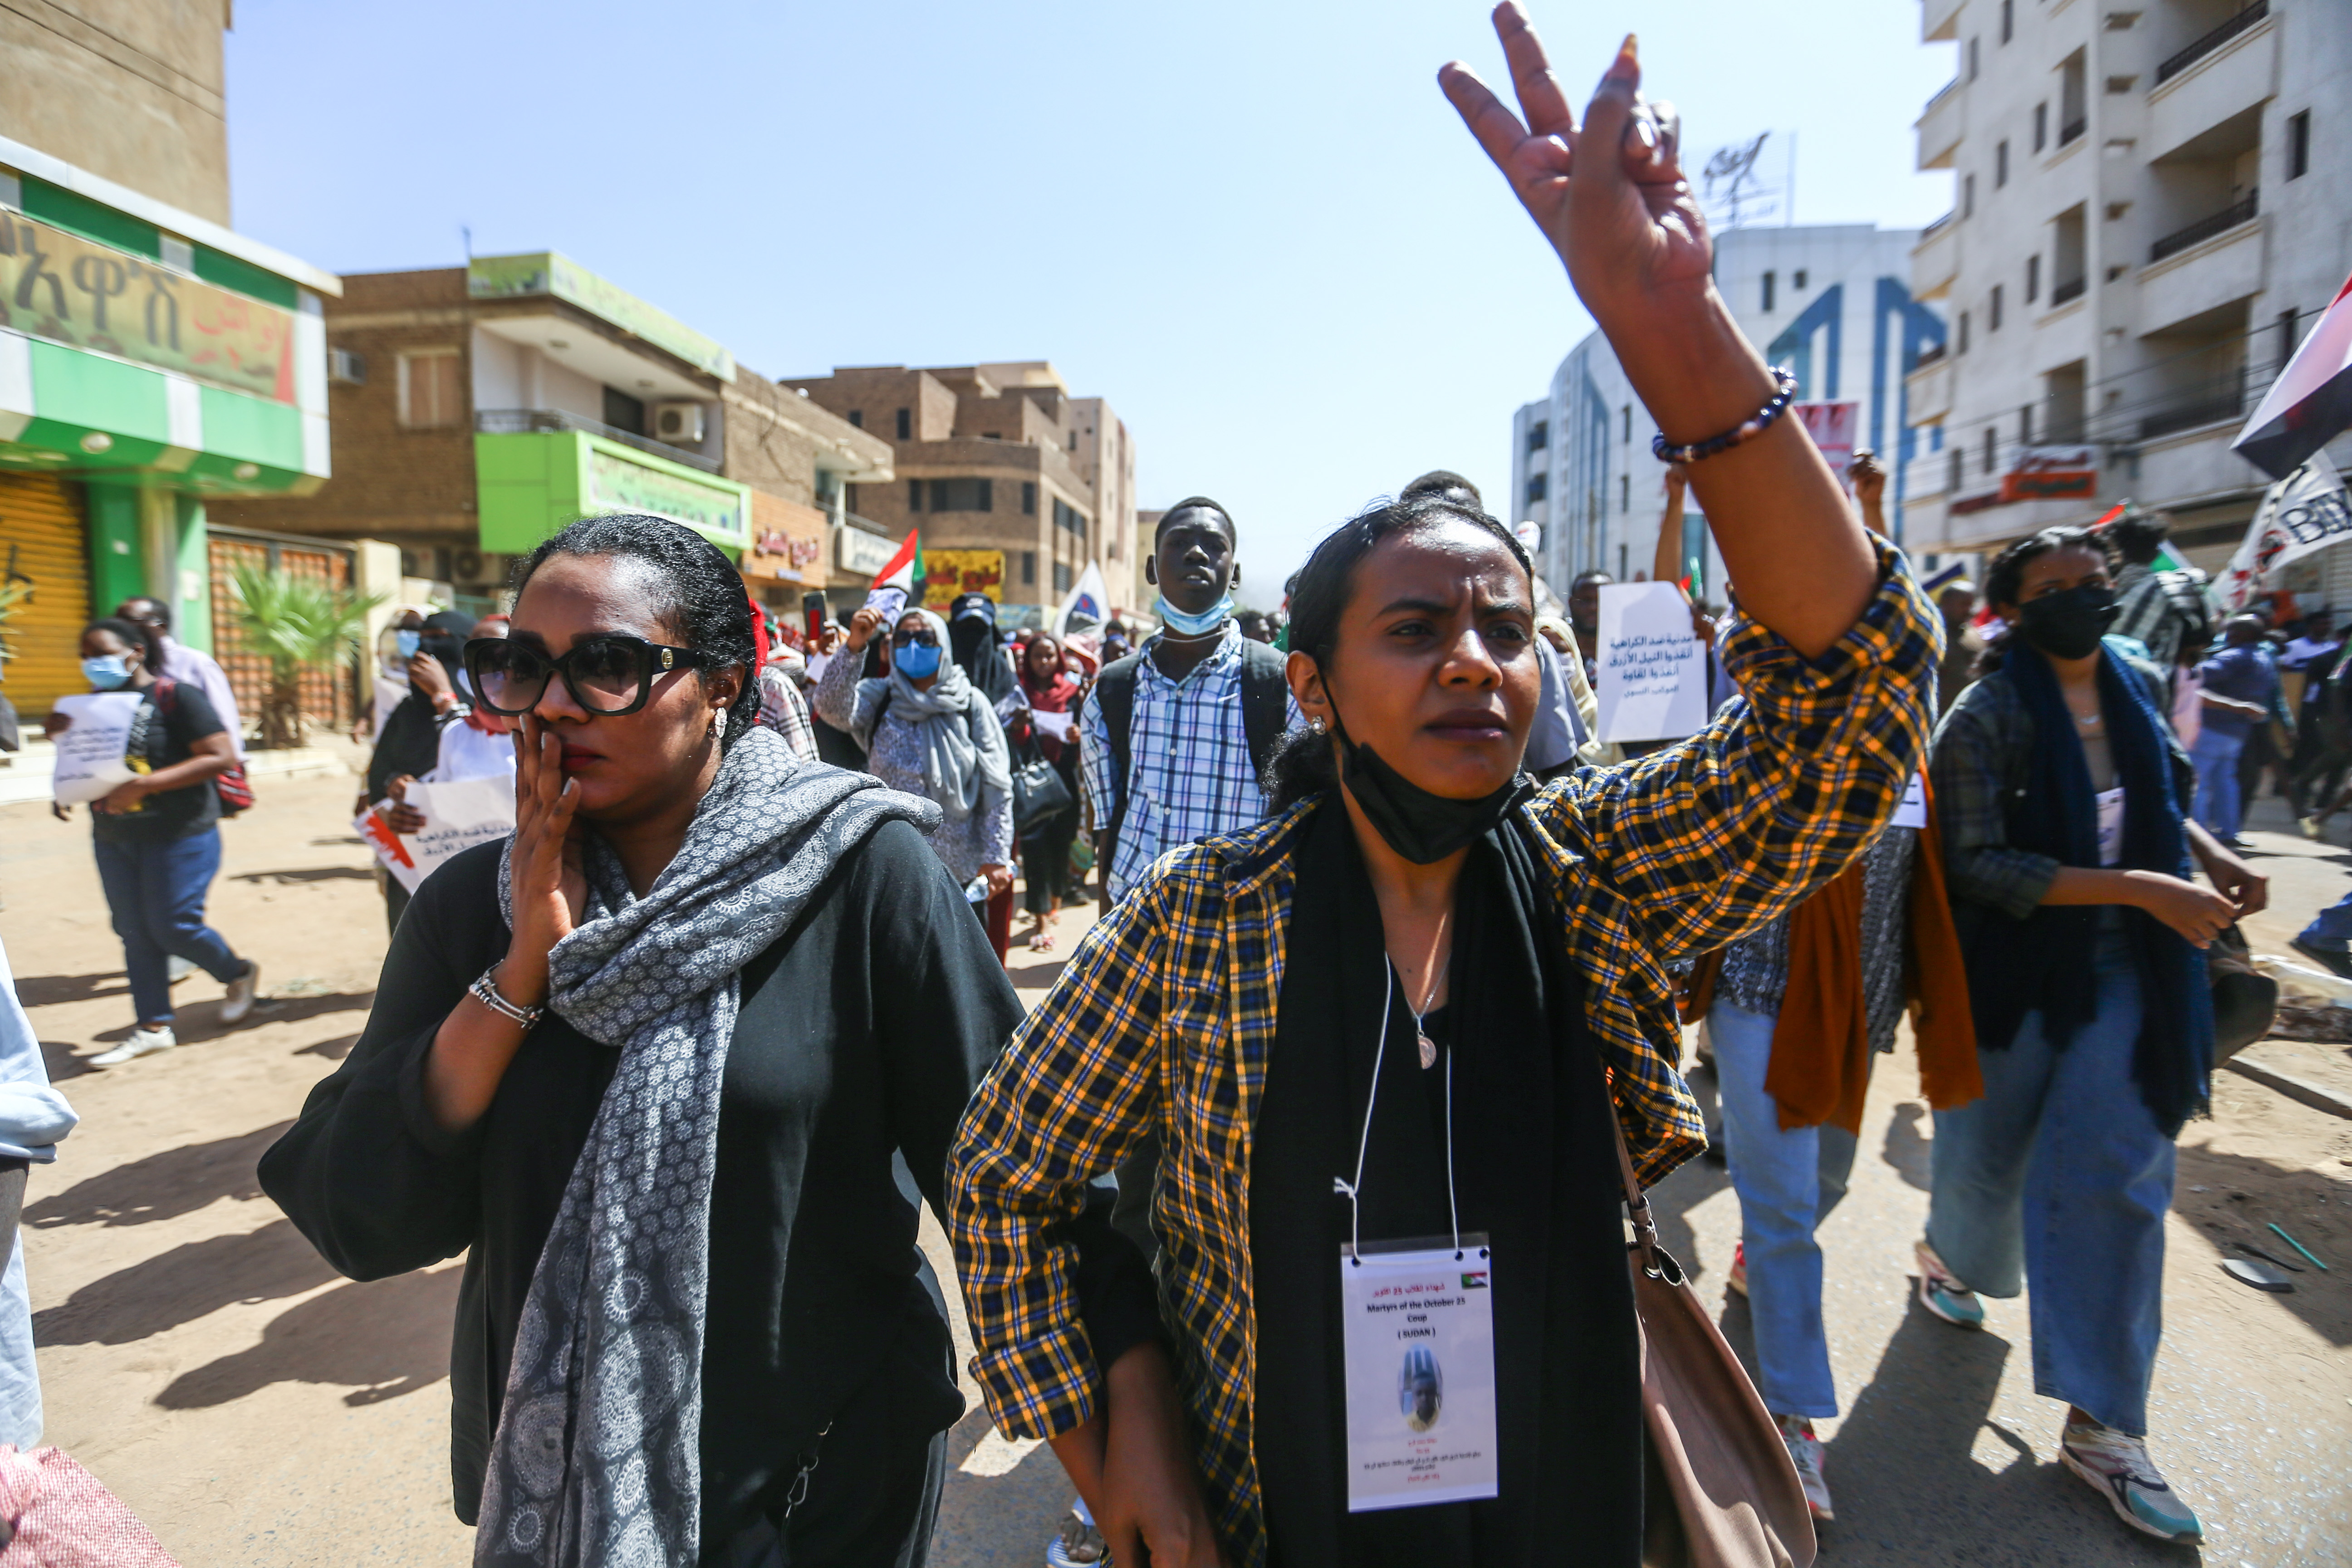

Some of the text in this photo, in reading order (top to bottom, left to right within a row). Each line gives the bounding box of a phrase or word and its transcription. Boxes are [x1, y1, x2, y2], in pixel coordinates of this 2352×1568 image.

[1639, 651, 1663, 664] النيل
[1393, 1287, 1403, 1296] 25
[1367, 1297, 1465, 1313] Martyrs of the October 25
[1407, 1314, 1427, 1323] Coup
[1403, 1328, 1431, 1339] SUDAN
